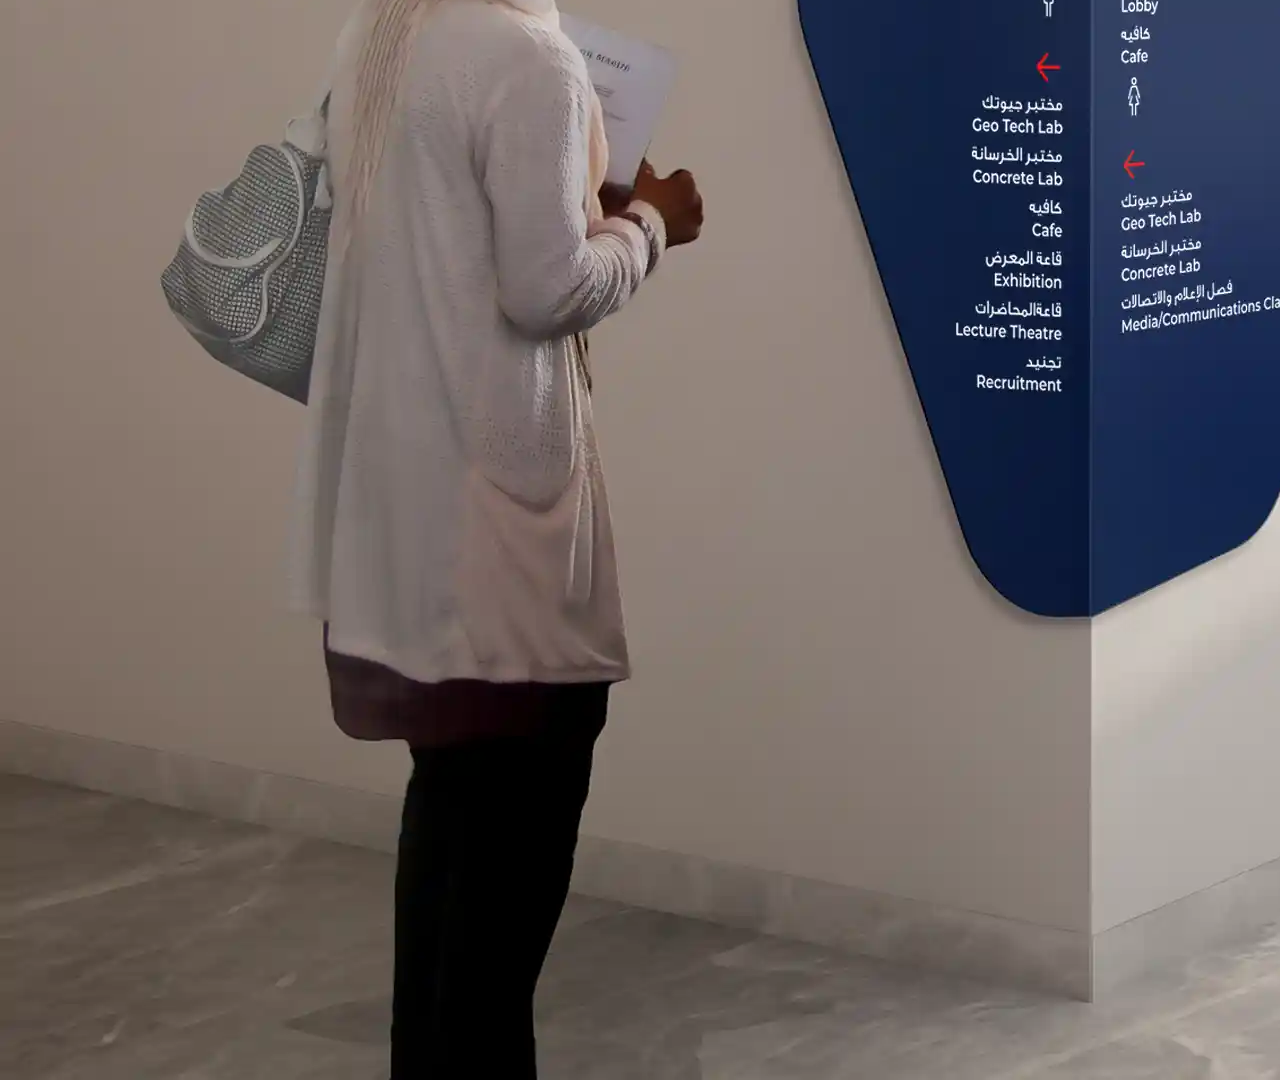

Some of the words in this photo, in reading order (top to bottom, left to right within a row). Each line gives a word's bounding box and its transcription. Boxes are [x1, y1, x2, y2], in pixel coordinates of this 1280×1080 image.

[1121, 26, 1150, 43] كافيه
[1121, 49, 1148, 63] Cafe
[982, 95, 1022, 113] جيوتك
[1025, 99, 1062, 114] مختبر
[972, 118, 999, 132] Geo
[1002, 119, 1034, 133] Tech
[1039, 120, 1063, 134] Lab
[972, 146, 1022, 164] الخرسانة
[1025, 150, 1062, 165] مختبر
[973, 170, 1034, 185] Concrete
[1039, 172, 1063, 186] Lab
[1121, 194, 1158, 210] جيوتك
[1160, 190, 1192, 207] مختبر
[1029, 199, 1062, 216] كافيه
[1121, 217, 1145, 230] Geo
[1148, 212, 1176, 227] Tech
[1180, 209, 1201, 223] Lab
[1032, 223, 1062, 237] Cafe
[1121, 240, 1167, 260] الخرسانة
[1169, 239, 1201, 256] مختبر
[986, 251, 1033, 267] المعرض
[1036, 251, 1062, 265] قاعة
[1121, 264, 1176, 281] Concrete
[1180, 258, 1200, 273] Lab
[995, 273, 1061, 289] Exhibition
[1175, 285, 1204, 305] الإعلام
[1207, 280, 1232, 300] فصل
[1121, 290, 1172, 310] والاتصالات
[1121, 299, 1261, 333] Media/Communications
[956, 322, 1006, 338] Lecture
[1010, 325, 1062, 340] Theatre
[1026, 356, 1061, 371] تجنيد
[977, 375, 1061, 392] Recruitment
